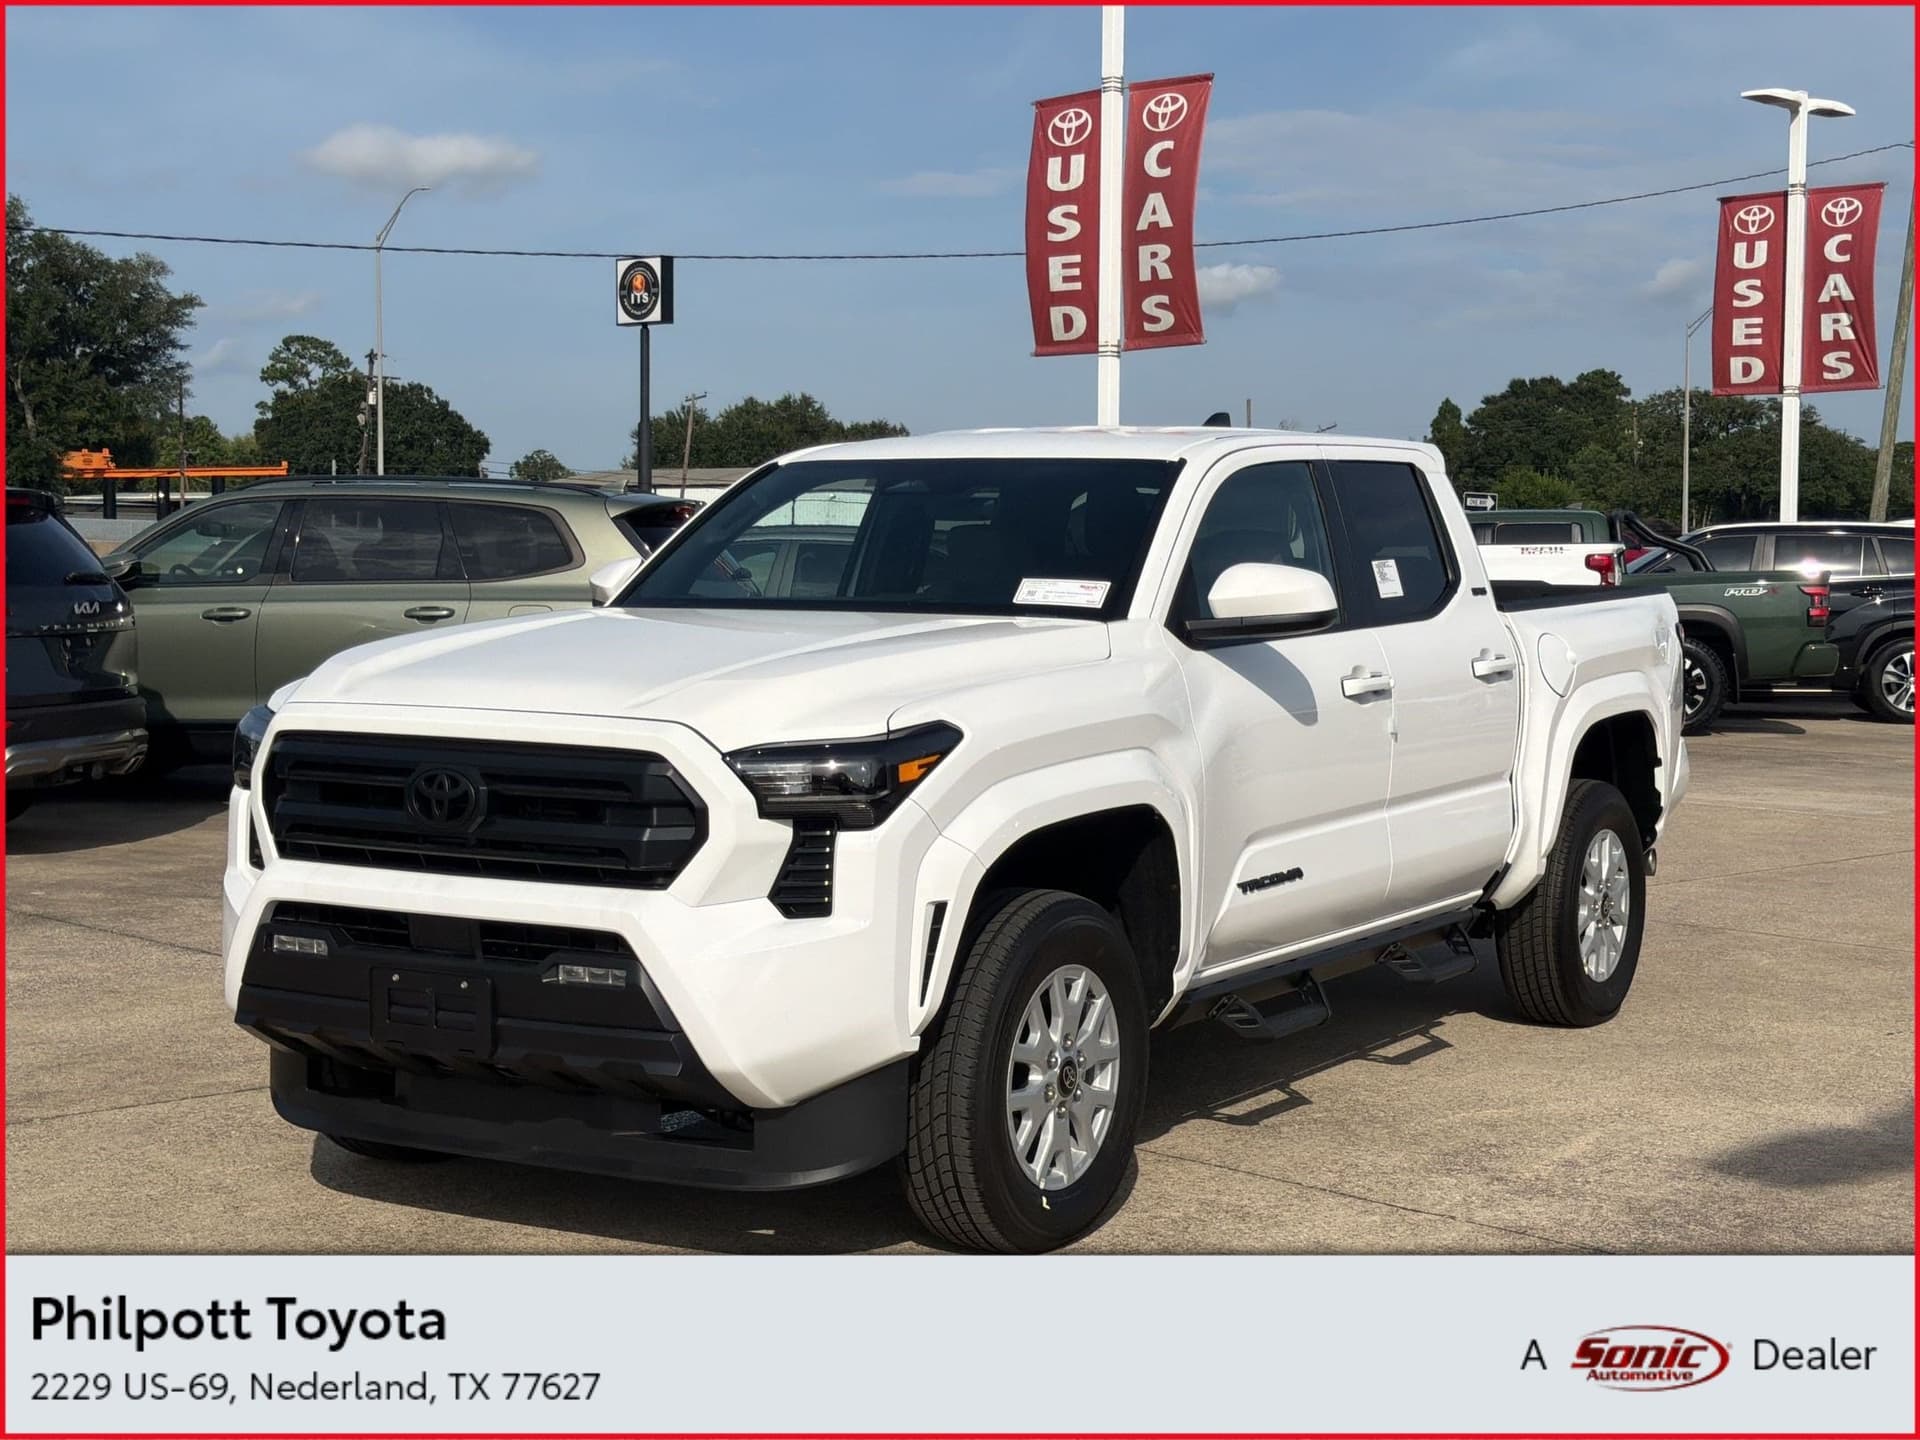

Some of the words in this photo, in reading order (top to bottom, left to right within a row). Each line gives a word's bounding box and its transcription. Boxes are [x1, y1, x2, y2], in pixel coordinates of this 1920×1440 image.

[630, 292, 649, 304] ITS
[1046, 153, 1087, 342] USED
[1136, 140, 1175, 333] CARS
[1817, 233, 1856, 380] CARS
[1730, 240, 1768, 384] USED
[73, 601, 100, 614] KIA
